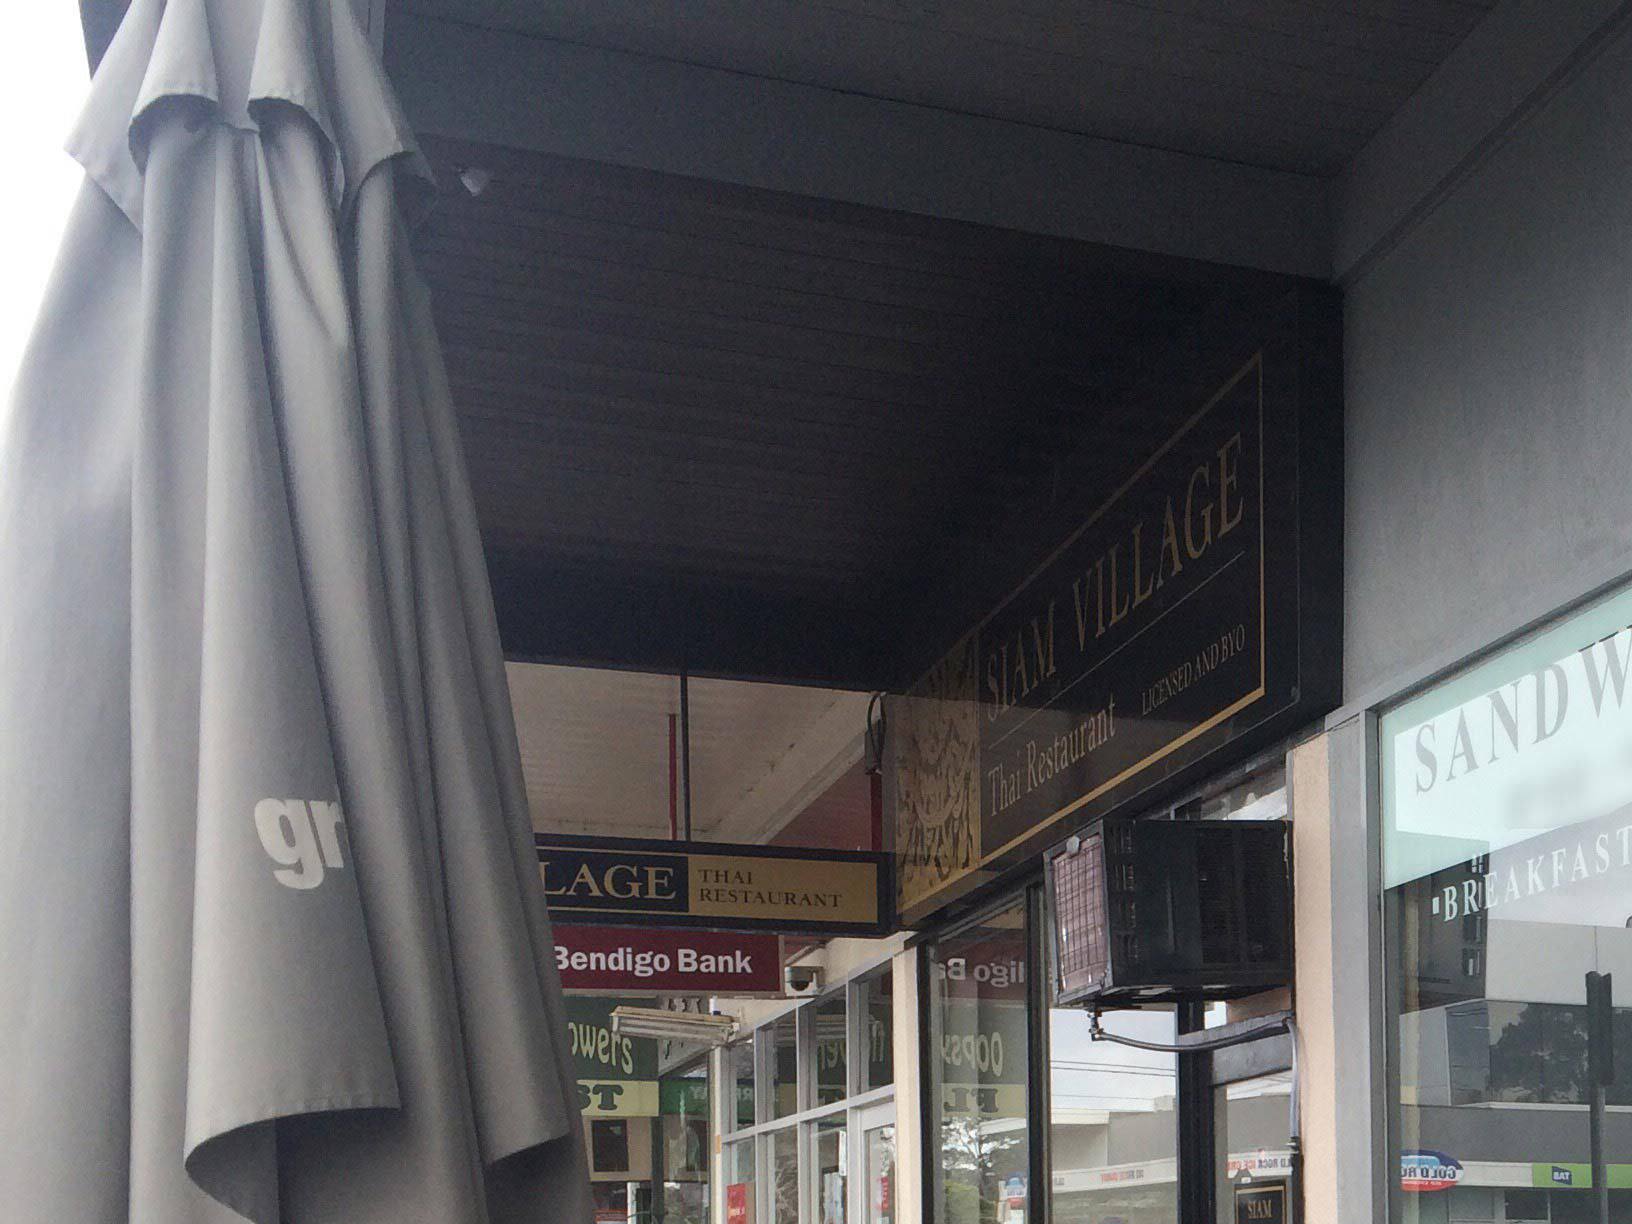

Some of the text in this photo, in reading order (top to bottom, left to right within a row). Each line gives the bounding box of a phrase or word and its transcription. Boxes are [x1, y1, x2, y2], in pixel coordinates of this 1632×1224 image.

[988, 432, 1244, 722] SIAM VILLAGE
[1141, 623, 1246, 716] LICENSED AND BYO
[988, 692, 1116, 816] Thai Restaurant
[699, 868, 753, 886] THAI
[699, 887, 843, 909] RESTAURANT
[554, 945, 753, 977] Bendigo Bank
[1247, 1199, 1273, 1219] SIAM
